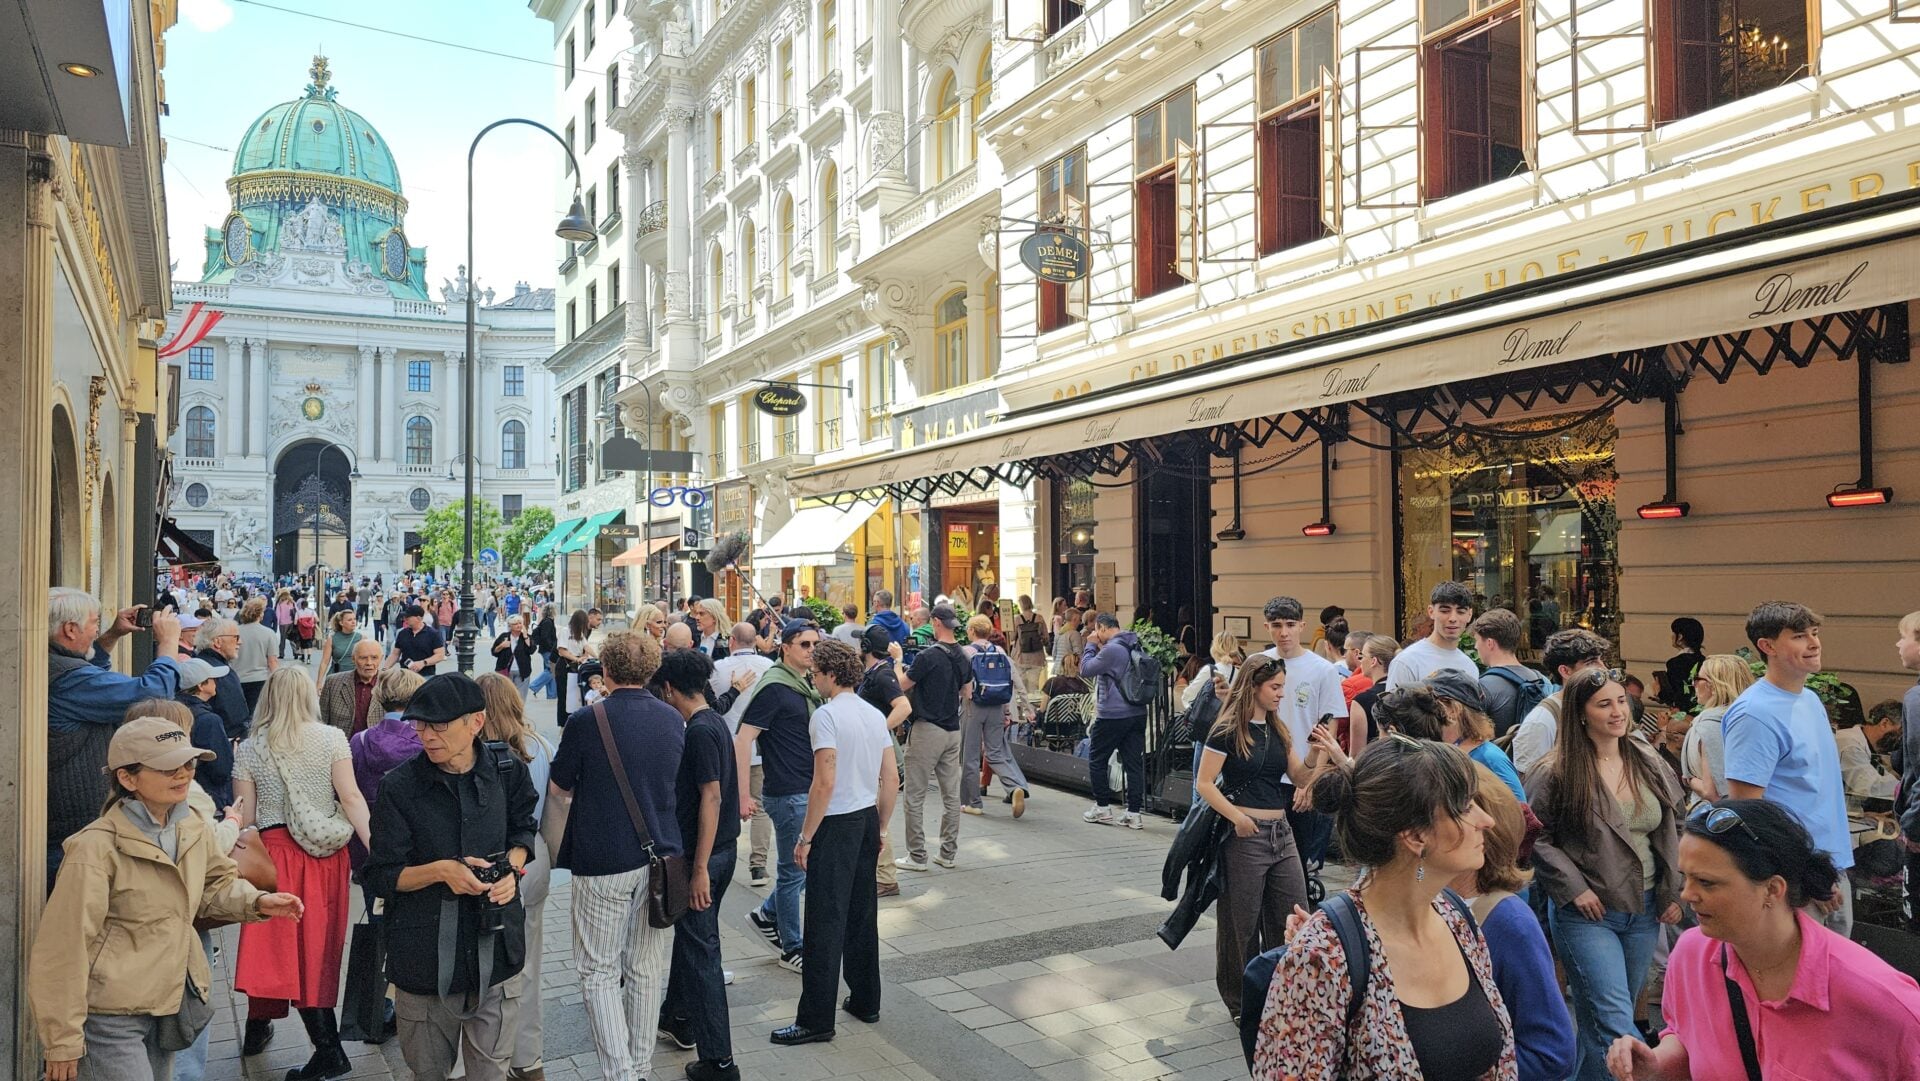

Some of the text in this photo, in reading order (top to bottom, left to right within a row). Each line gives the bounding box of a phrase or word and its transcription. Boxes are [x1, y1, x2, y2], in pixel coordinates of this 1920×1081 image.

[1037, 246, 1080, 262] DEMEL
[1748, 261, 1869, 320] Demel
[1497, 321, 1582, 367] Demel
[1318, 363, 1381, 400] Demel
[759, 390, 802, 407] Chopard
[1186, 394, 1234, 424] Demel
[1467, 489, 1547, 509] DEMEL
[949, 537, 967, 548] -70%
